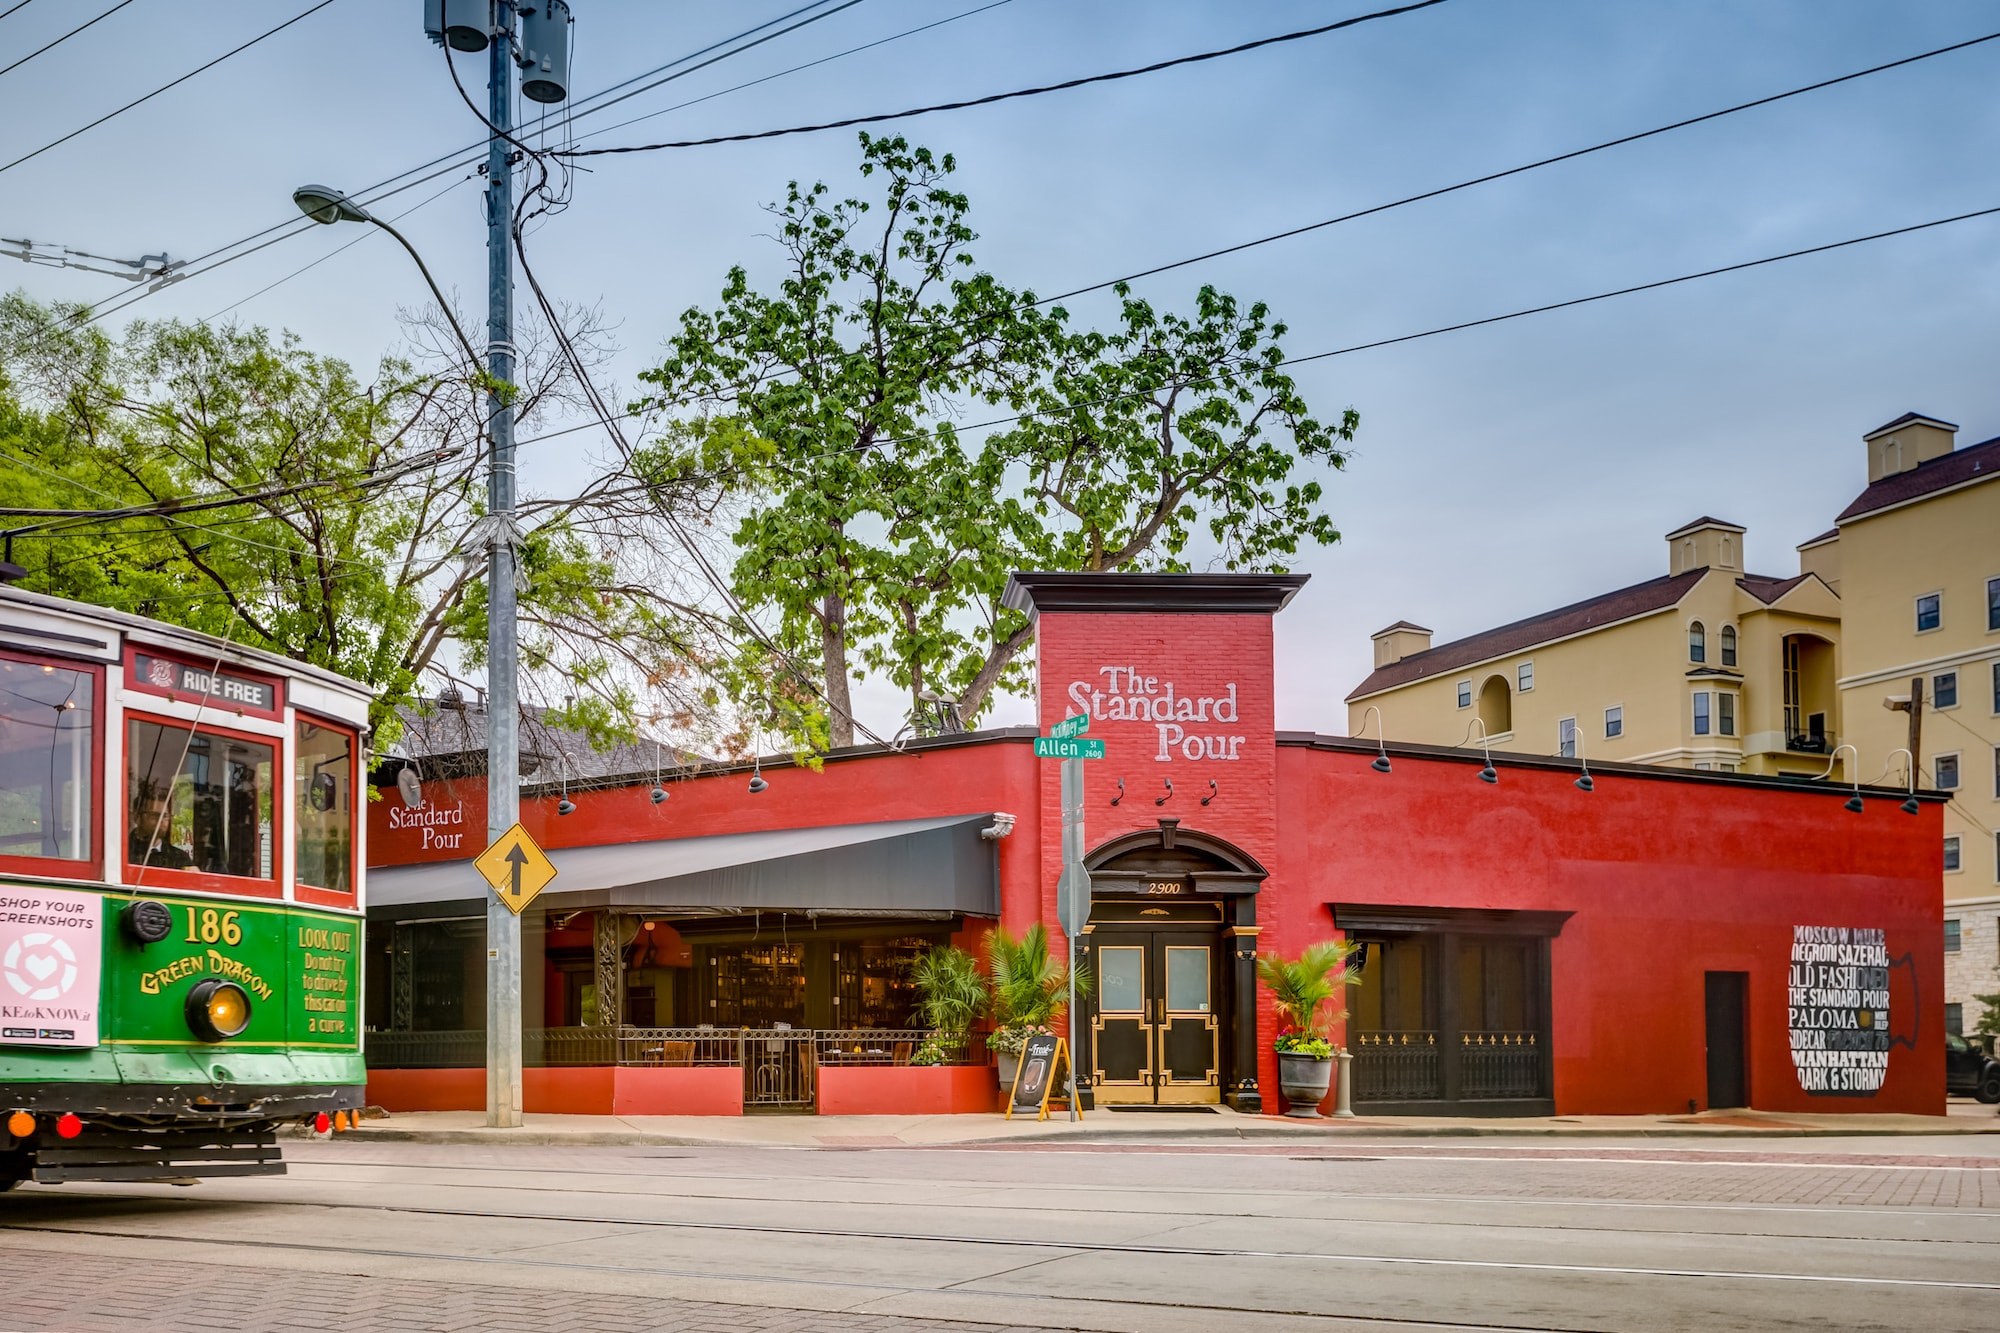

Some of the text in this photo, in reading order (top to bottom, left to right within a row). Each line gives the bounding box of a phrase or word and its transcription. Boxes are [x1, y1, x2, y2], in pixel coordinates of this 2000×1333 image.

[183, 670, 221, 695] RIDE
[224, 680, 262, 705] FREE
[1099, 666, 1159, 694] The
[1066, 681, 1239, 722] Standard
[1038, 739, 1078, 756] Allen
[1154, 723, 1246, 762] Pour
[1085, 749, 1102, 758] 2600
[389, 800, 463, 829] Standard
[421, 827, 463, 849] Pour
[1148, 882, 1180, 894] 2900
[0, 897, 85, 913] SHOP YOUR
[0, 912, 94, 929] CREENSHOTS
[184, 906, 242, 946] 186
[298, 926, 351, 953] LOOK OUT
[1793, 925, 1885, 946] MOSCOW MULE
[304, 952, 318, 970] Do
[1838, 944, 1889, 967] SAZERAC
[140, 949, 273, 1001] GREEN DRAGON
[302, 973, 313, 990] to
[314, 974, 337, 992] drive
[1788, 964, 1889, 989] OLD FASHIONED
[304, 993, 347, 1013] this car on
[1788, 987, 1889, 1009] THE STANDARD POUR
[0, 1005, 90, 1021] KEtoKNOW.it
[1788, 1008, 1859, 1029] PALOMA
[308, 1018, 345, 1034] a curve
[1788, 1029, 1826, 1049] SIDECAR
[1791, 1050, 1888, 1068] MANHATTAN
[1797, 1067, 1886, 1090] DARK & STORMY
